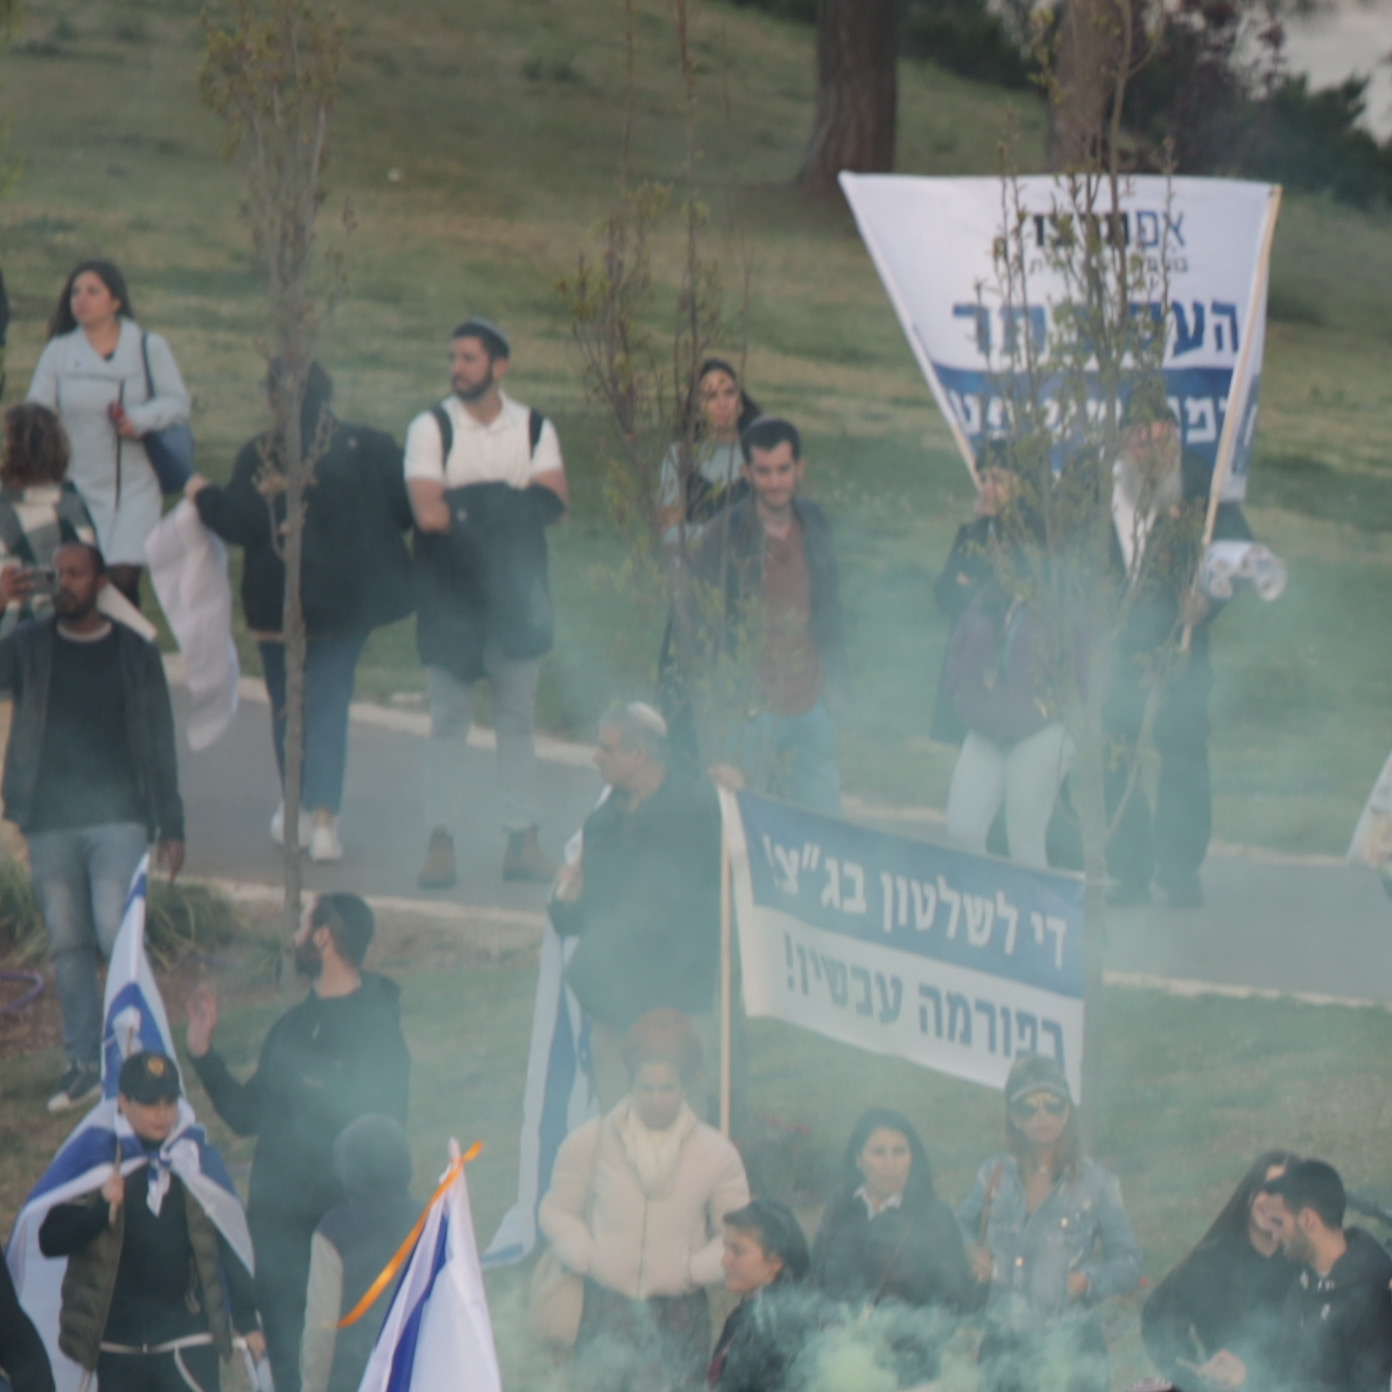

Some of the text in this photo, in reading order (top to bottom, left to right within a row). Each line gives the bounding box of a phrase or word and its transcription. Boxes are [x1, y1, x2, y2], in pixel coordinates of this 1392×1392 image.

[879, 871, 1019, 957] לשלטון
[1030, 908, 1067, 971] די
[784, 931, 1066, 1074] רפורמה עכשיו!
